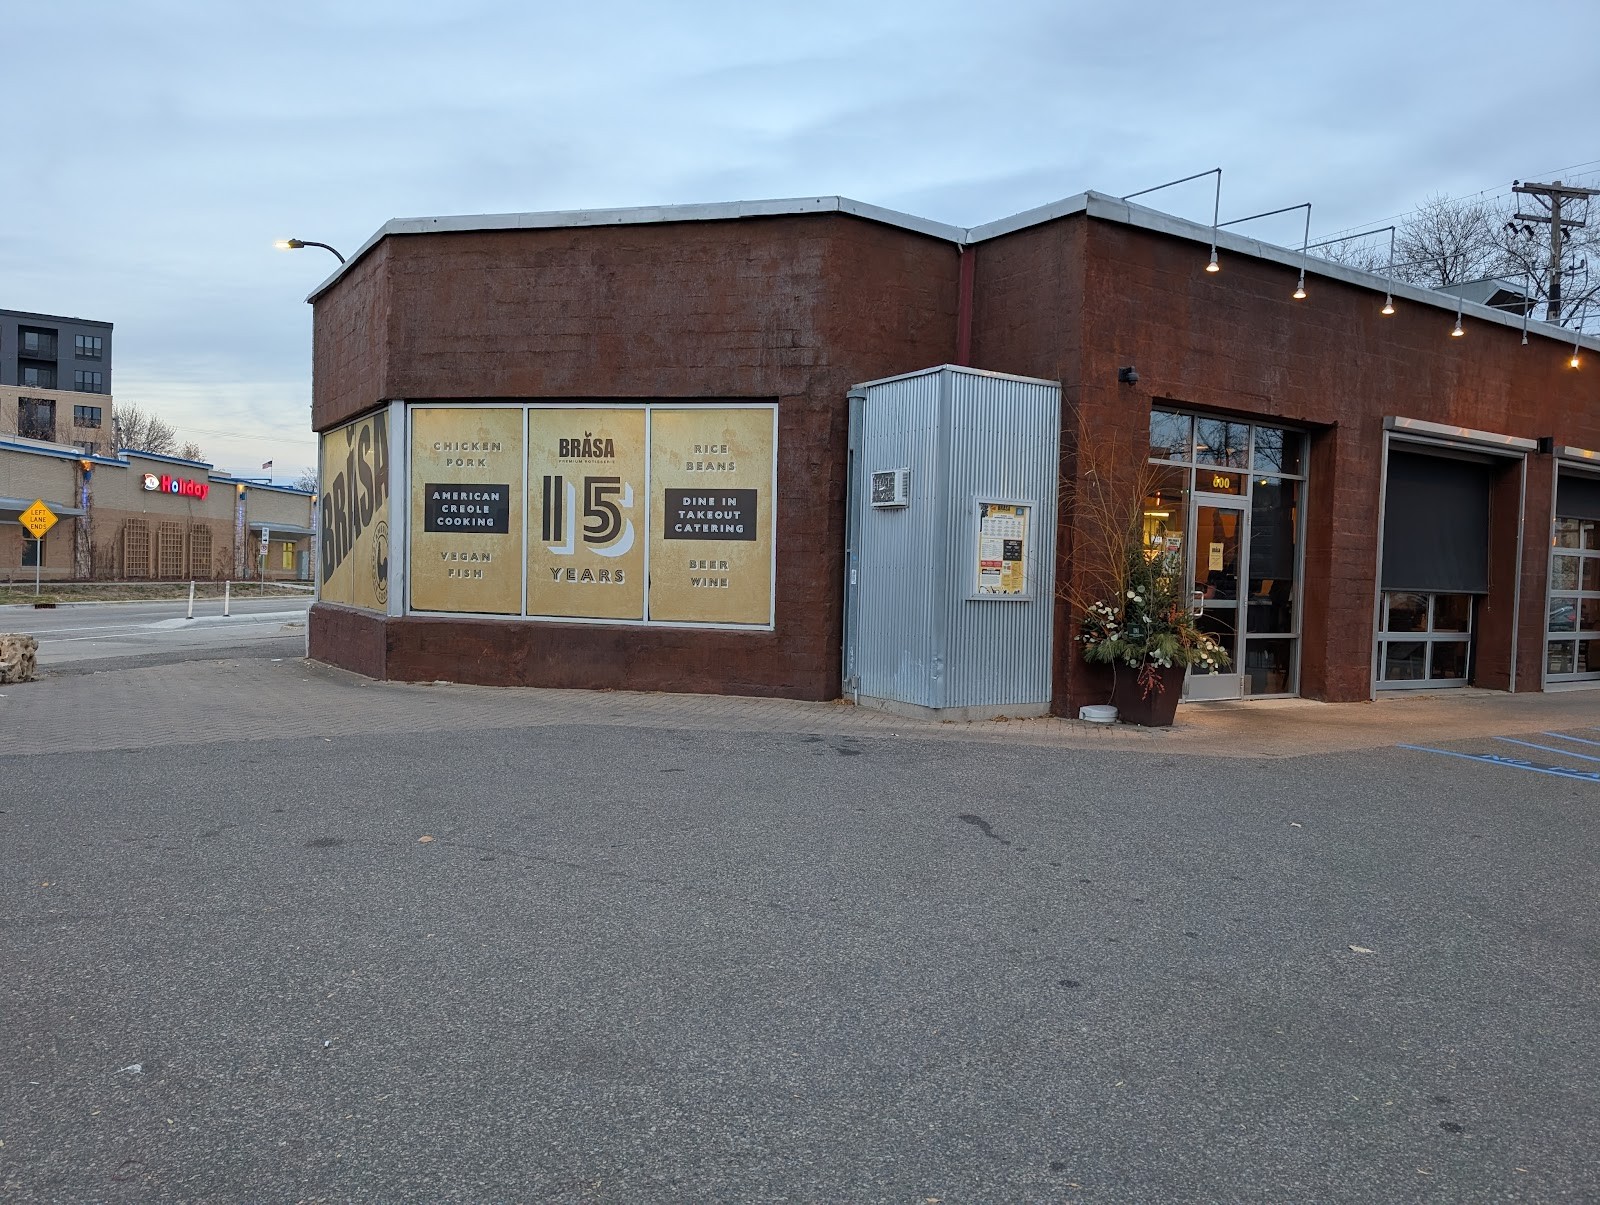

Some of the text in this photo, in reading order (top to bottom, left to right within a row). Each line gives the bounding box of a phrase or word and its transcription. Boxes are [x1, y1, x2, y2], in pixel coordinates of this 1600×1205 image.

[433, 441, 502, 452] CHICKEN
[559, 438, 615, 458] BRASA
[694, 444, 729, 455] RICE
[446, 458, 487, 467] PORK
[686, 461, 736, 472] BEANS
[161, 474, 209, 501] Holiday
[432, 491, 500, 501] AMERICAN
[682, 496, 737, 506] DINE IN
[441, 504, 490, 514] CREOLE
[542, 475, 635, 557] 15
[678, 510, 741, 520] TAKEOUT
[436, 517, 494, 527] COOKING
[674, 523, 744, 534] CATERING
[440, 551, 492, 562] VEGAN
[689, 559, 729, 571] BEER
[448, 568, 483, 578] FISH
[550, 567, 625, 584] YEARS
[690, 577, 729, 588] WINE
